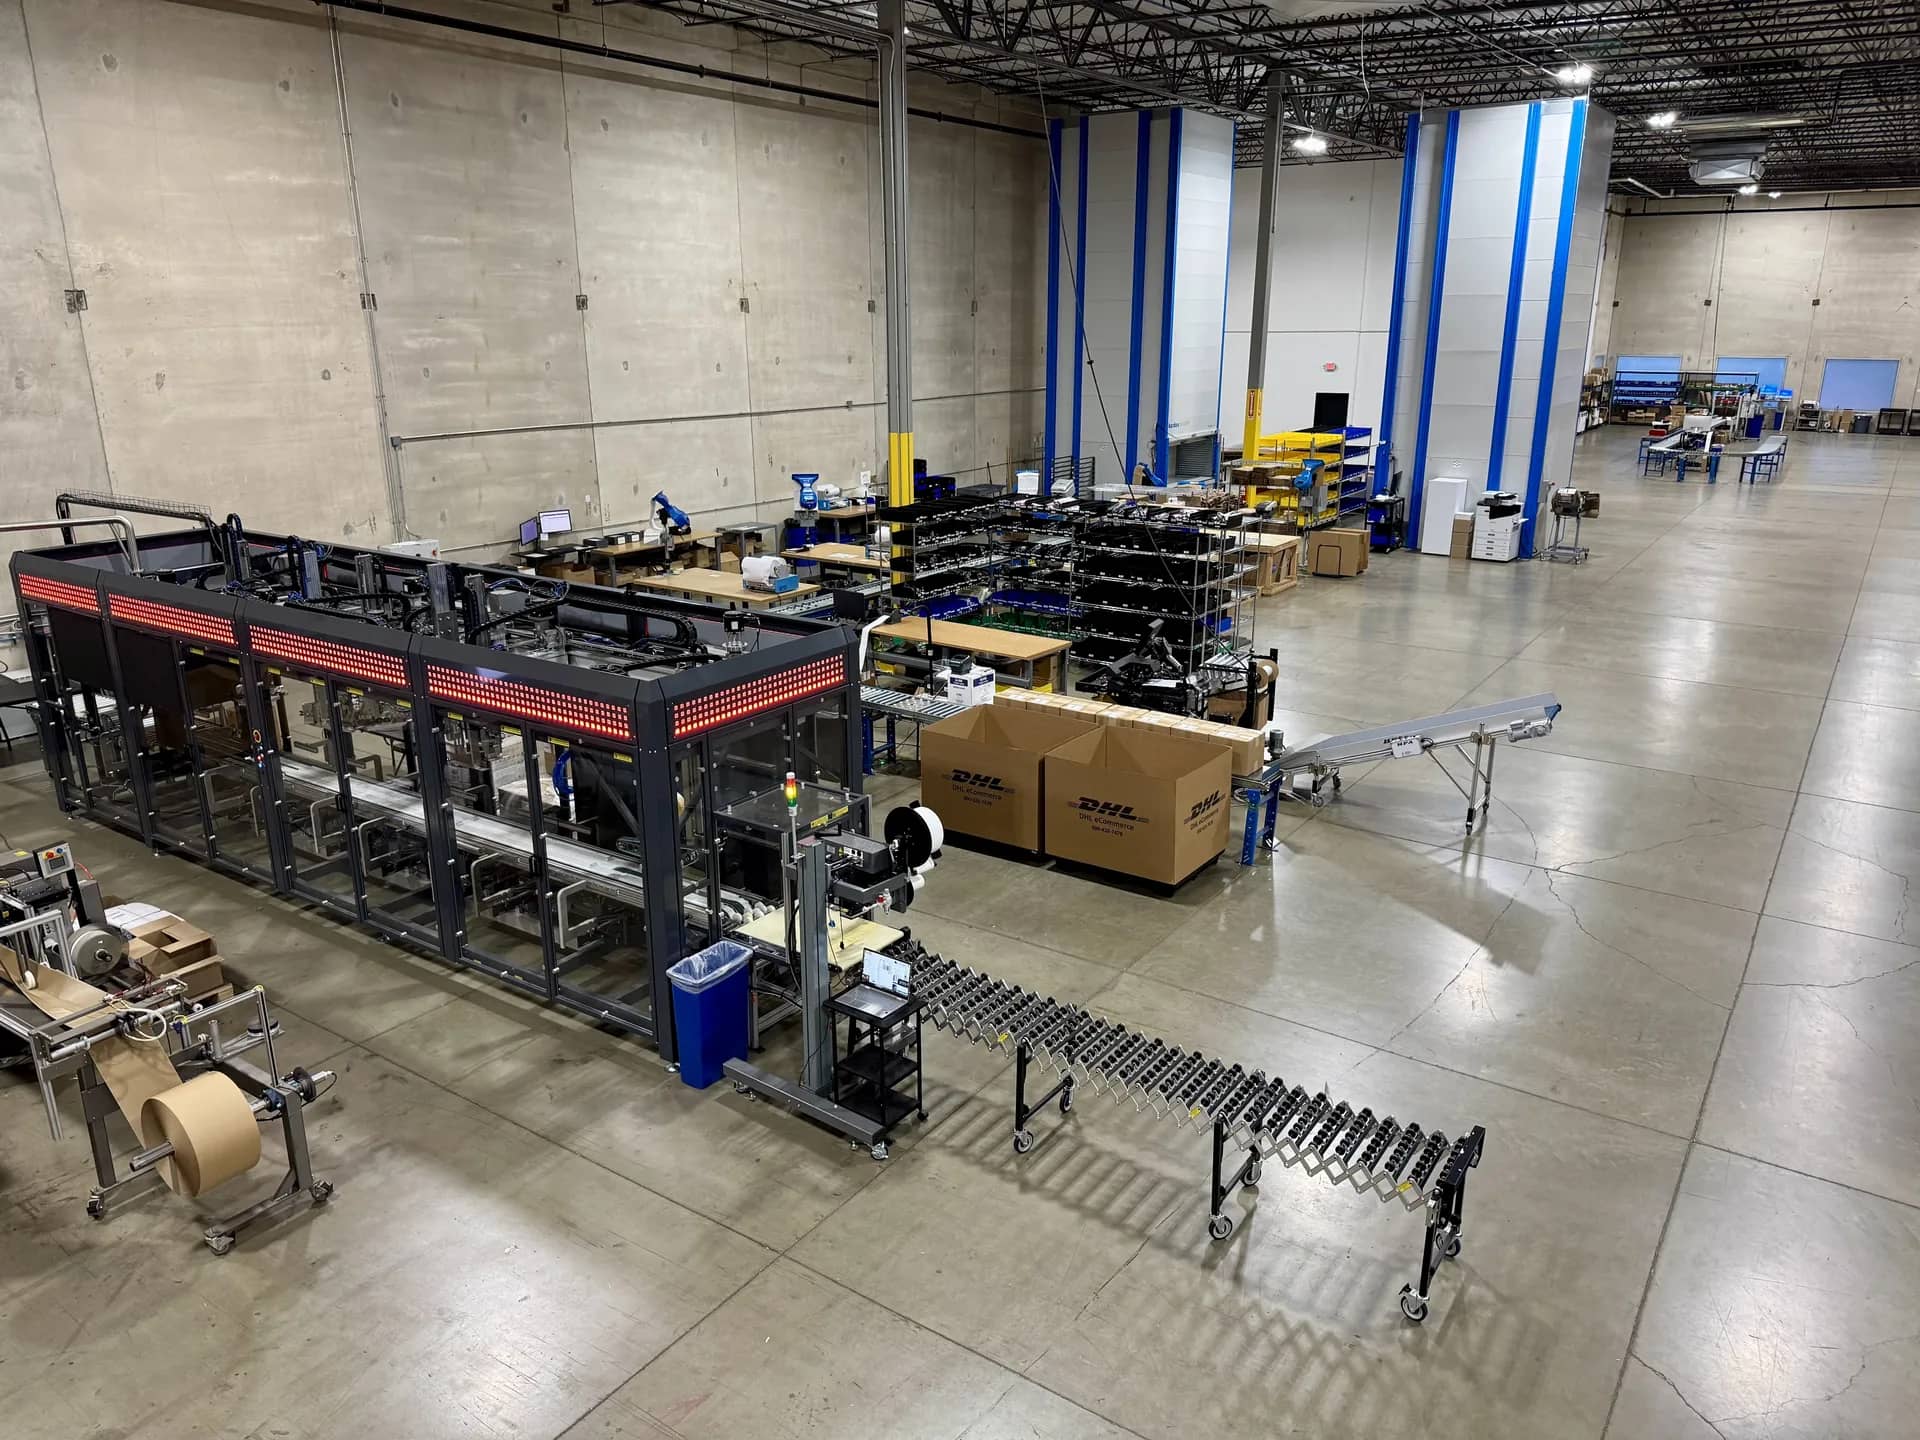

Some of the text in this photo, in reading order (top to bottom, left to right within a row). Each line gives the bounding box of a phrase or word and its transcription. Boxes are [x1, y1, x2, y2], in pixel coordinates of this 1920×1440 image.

[951, 769, 1005, 791] DHL
[1079, 796, 1137, 821] DHL
[1191, 790, 1220, 820] DHL
[1079, 812, 1093, 822] DHL
[1094, 817, 1135, 831] eCommerce
